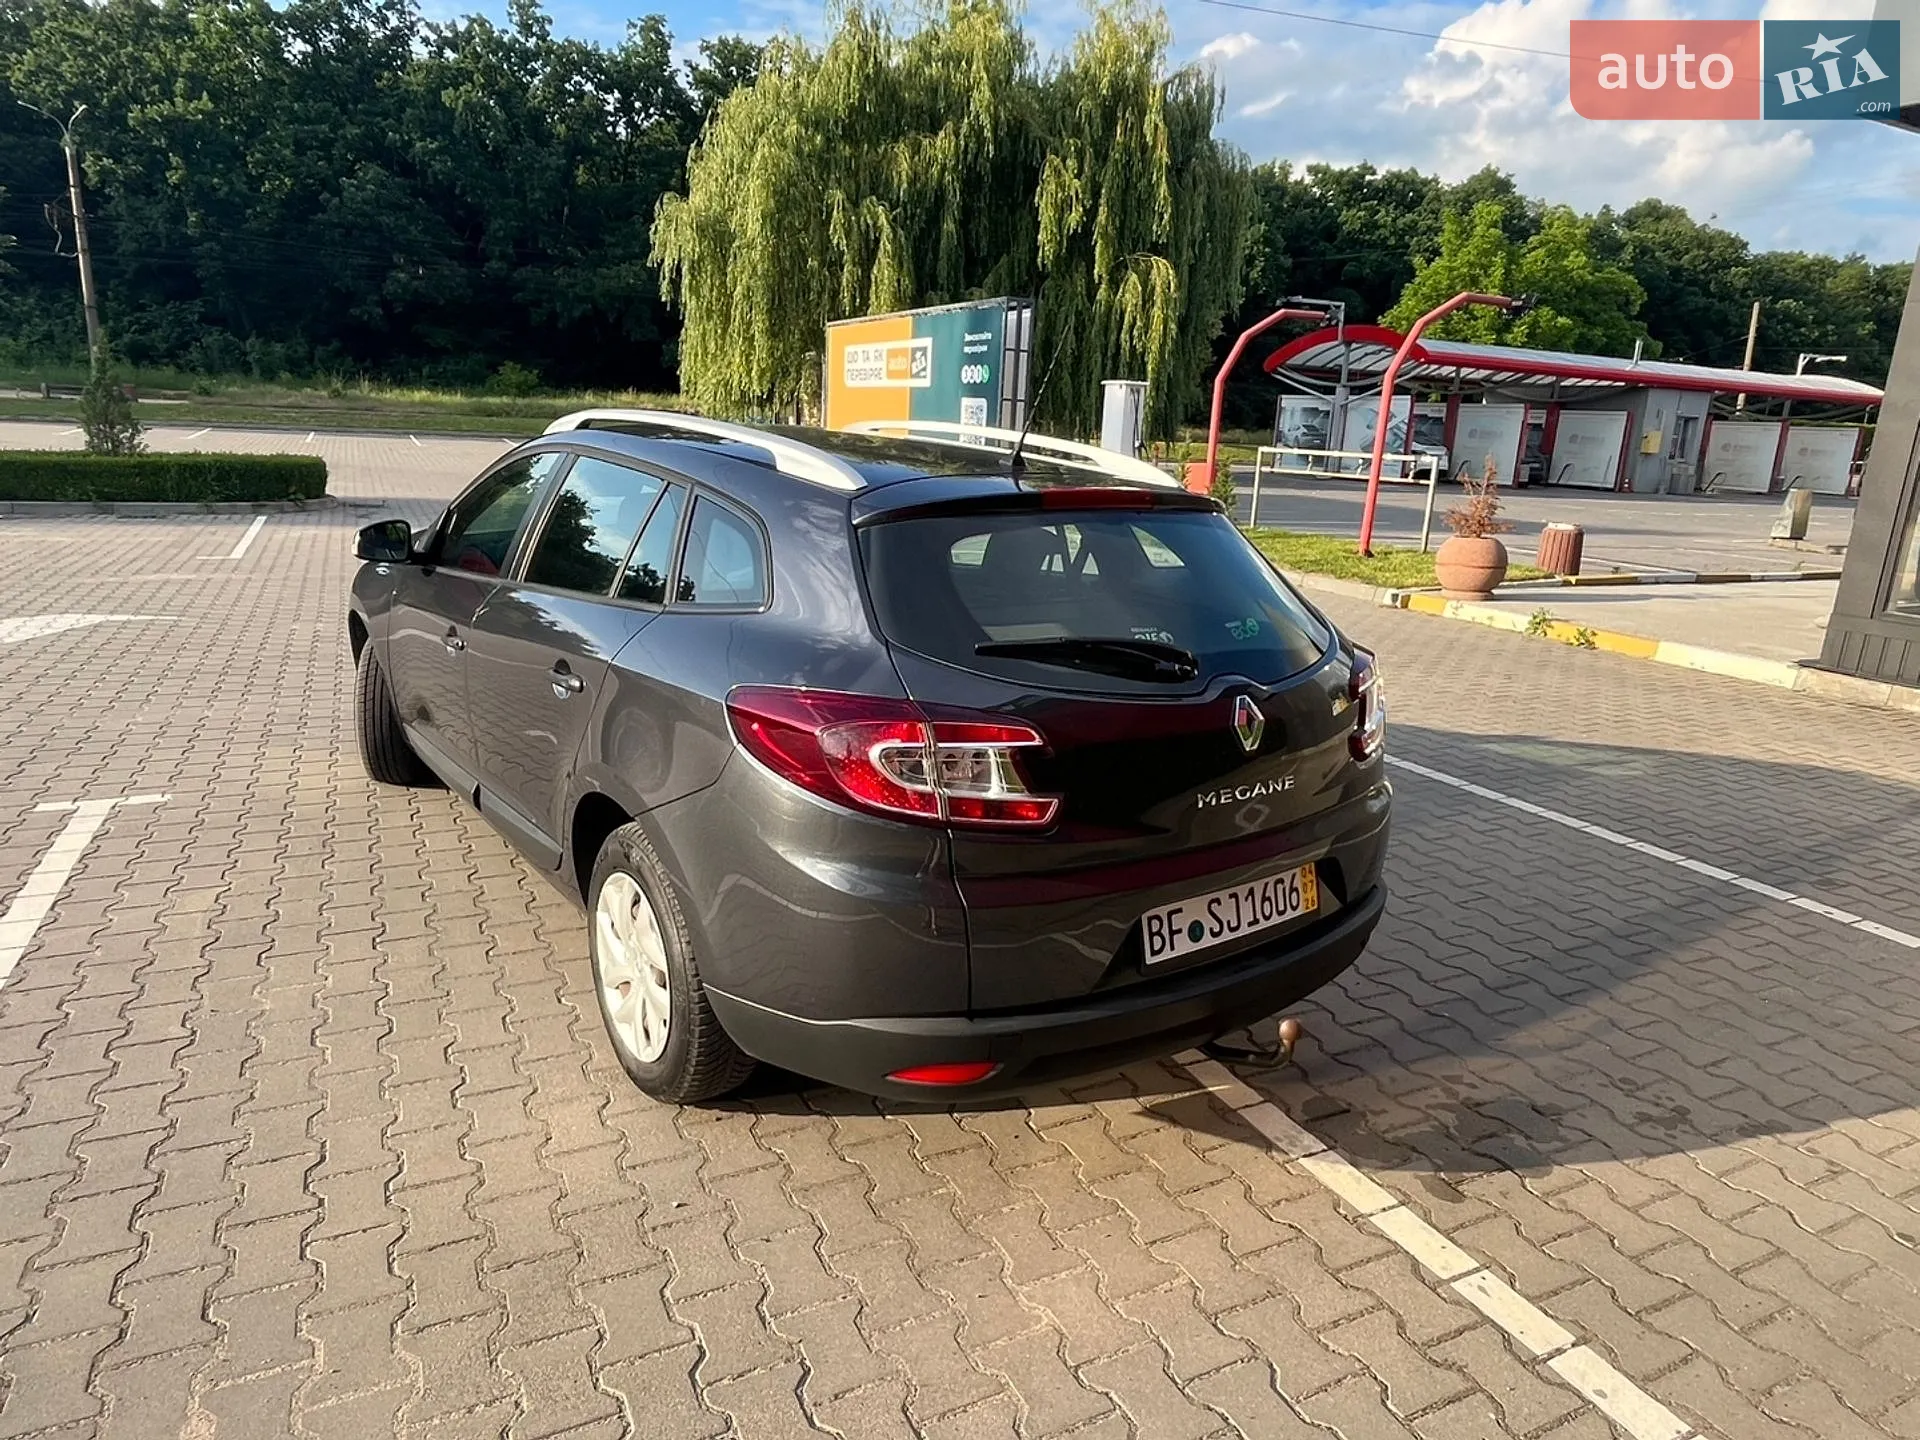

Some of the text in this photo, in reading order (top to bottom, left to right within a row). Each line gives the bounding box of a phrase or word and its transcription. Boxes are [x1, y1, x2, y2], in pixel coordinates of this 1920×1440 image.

[1197, 774, 1296, 808] MEGANE
[1303, 879, 1315, 894] 07
[1147, 873, 1300, 957] BF SJ1606
